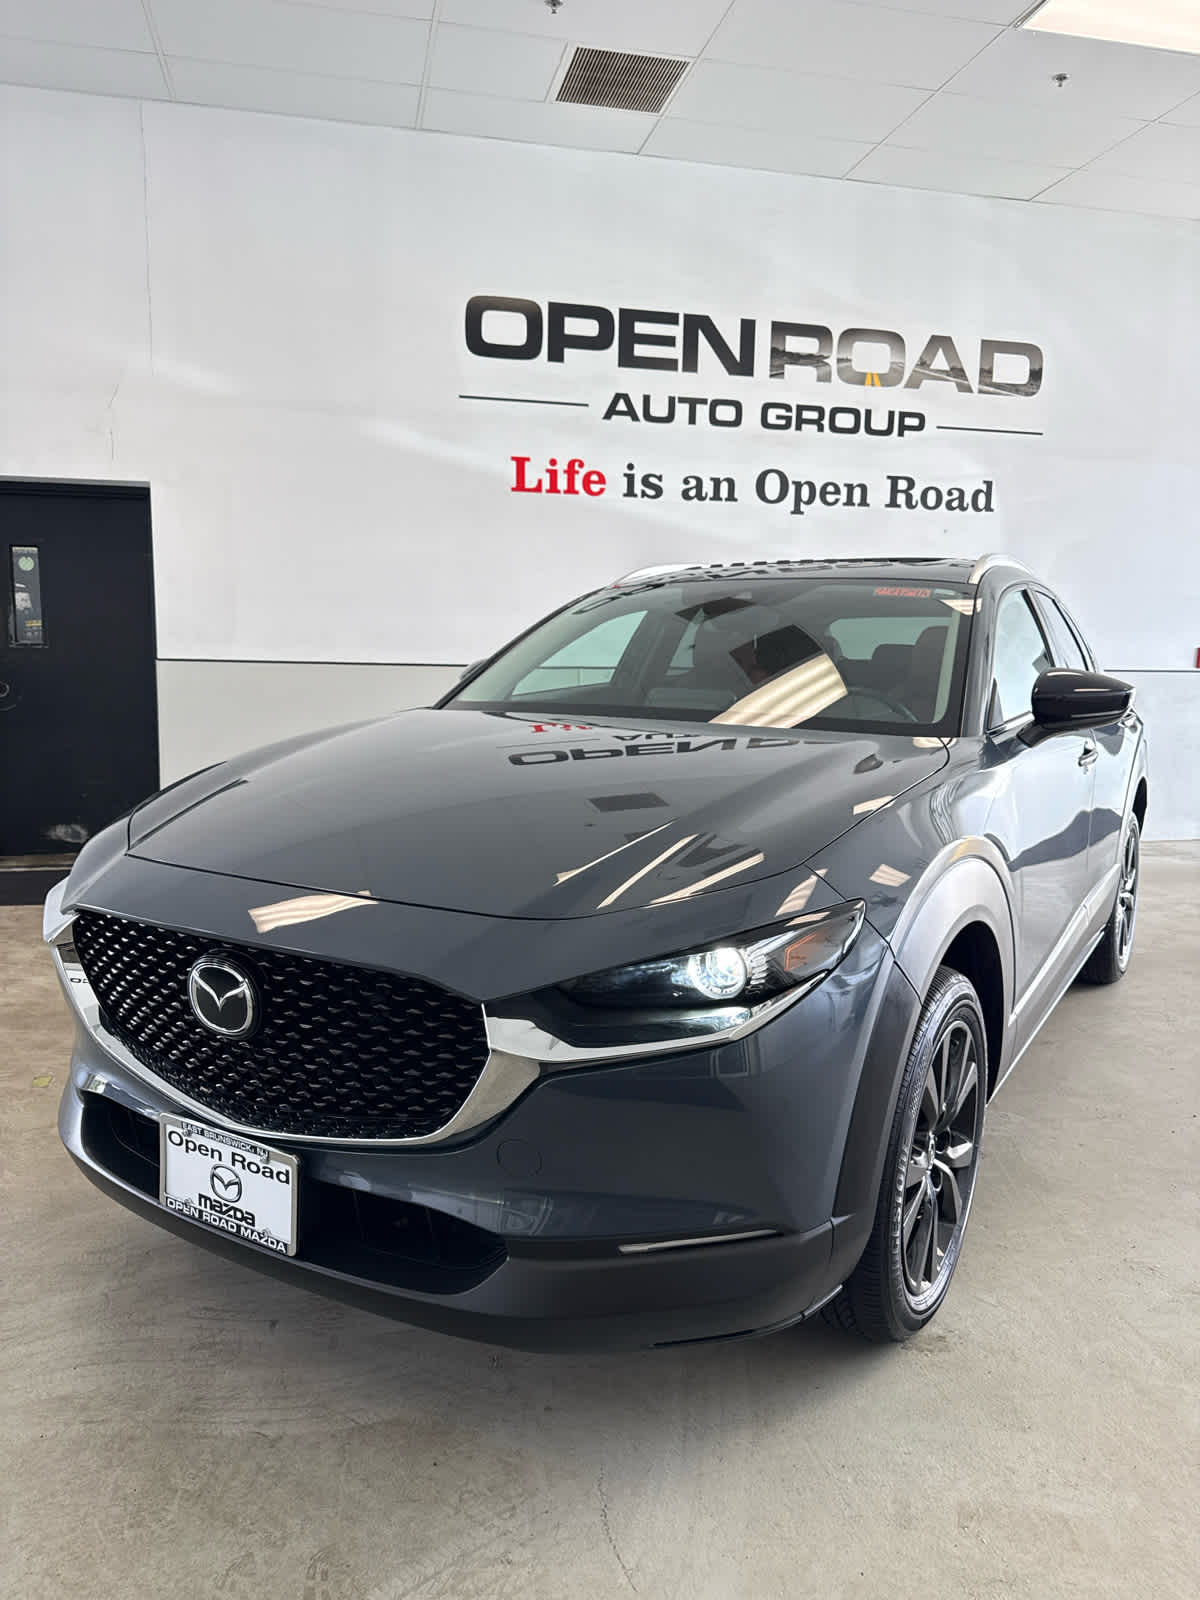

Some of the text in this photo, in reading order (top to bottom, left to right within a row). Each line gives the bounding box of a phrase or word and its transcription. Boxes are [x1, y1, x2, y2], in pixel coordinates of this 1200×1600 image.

[465, 295, 1044, 397] OPEN ROAD
[602, 392, 926, 437] AUTO GROUP
[510, 456, 995, 514] Life is an Open Road
[168, 1130, 290, 1184] Open Road
[167, 1199, 287, 1254] OPEN ROAD MAZDA
